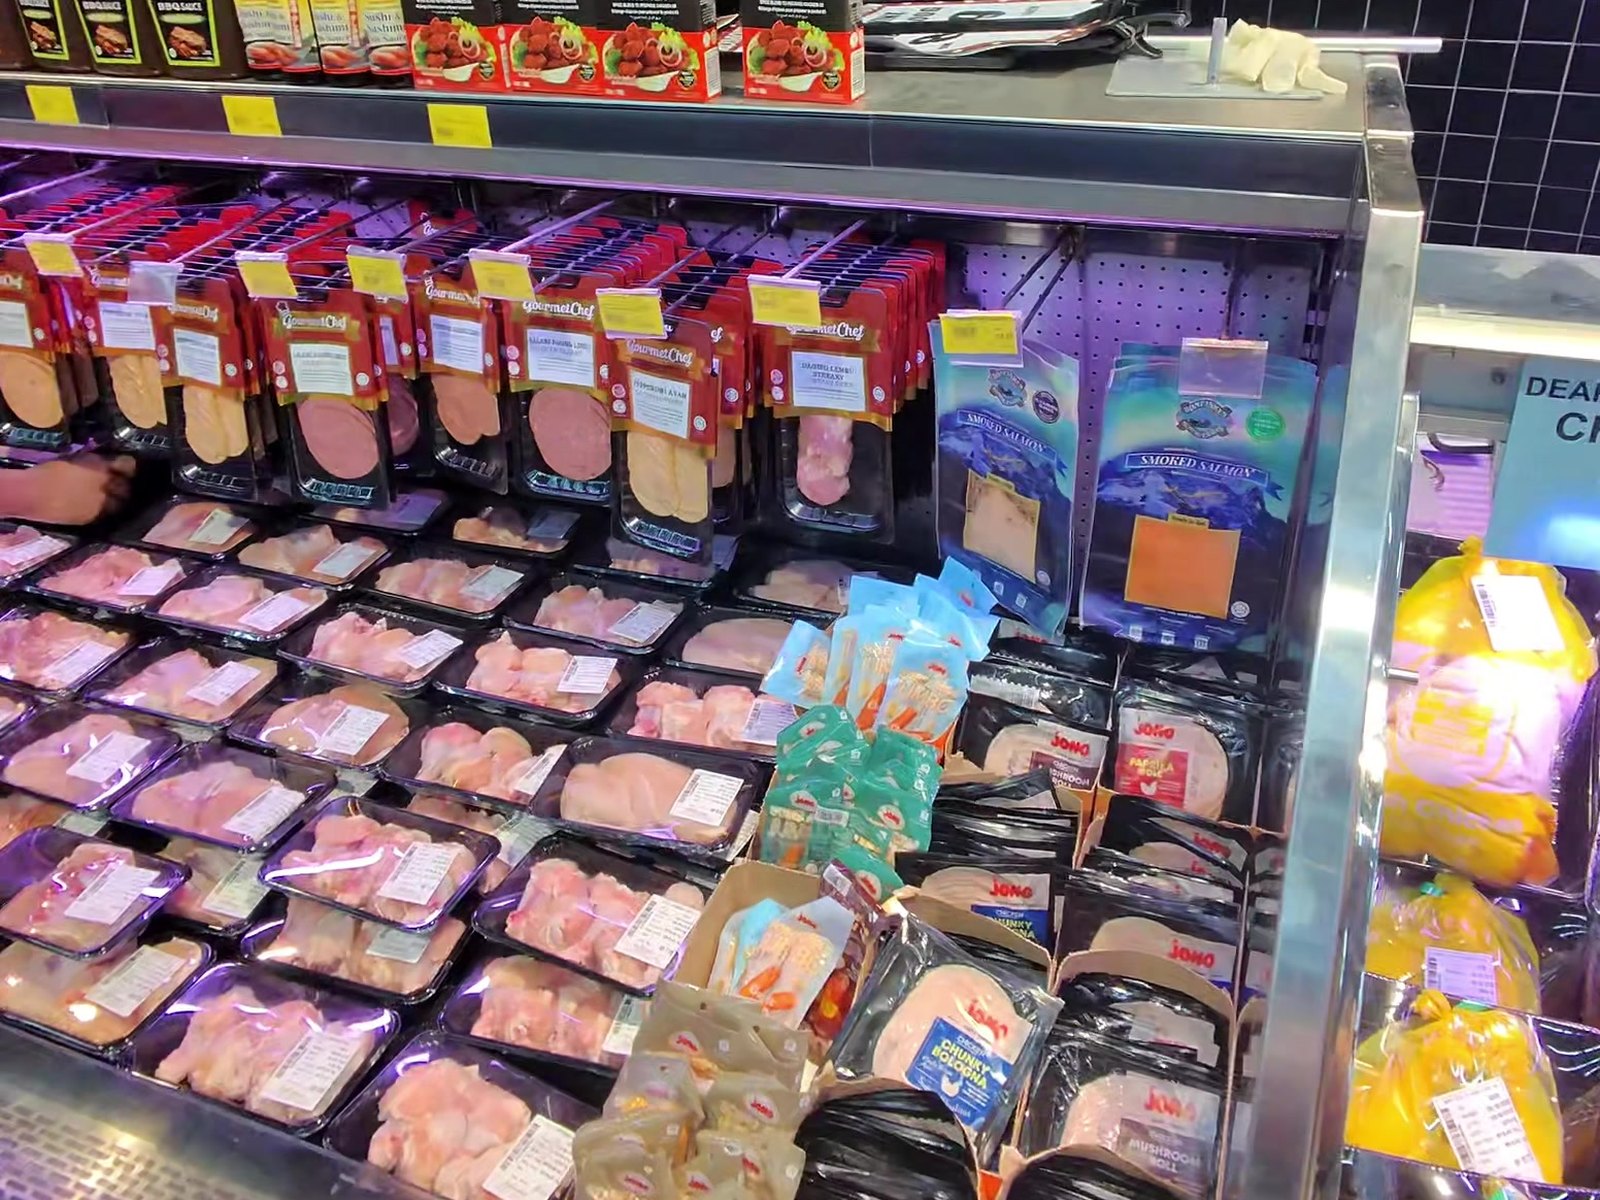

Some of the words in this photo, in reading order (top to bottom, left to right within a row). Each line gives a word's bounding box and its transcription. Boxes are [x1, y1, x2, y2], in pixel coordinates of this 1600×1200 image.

[967, 413, 1002, 435] SMOKED
[1003, 425, 1044, 453] SALMON
[1141, 454, 1197, 469] SMOKED
[1199, 460, 1252, 479] SALMON
[931, 1046, 988, 1089] BOLOGNA
[940, 1038, 992, 1074] CHUNKY
[1129, 1138, 1201, 1166] MUSHROOM
